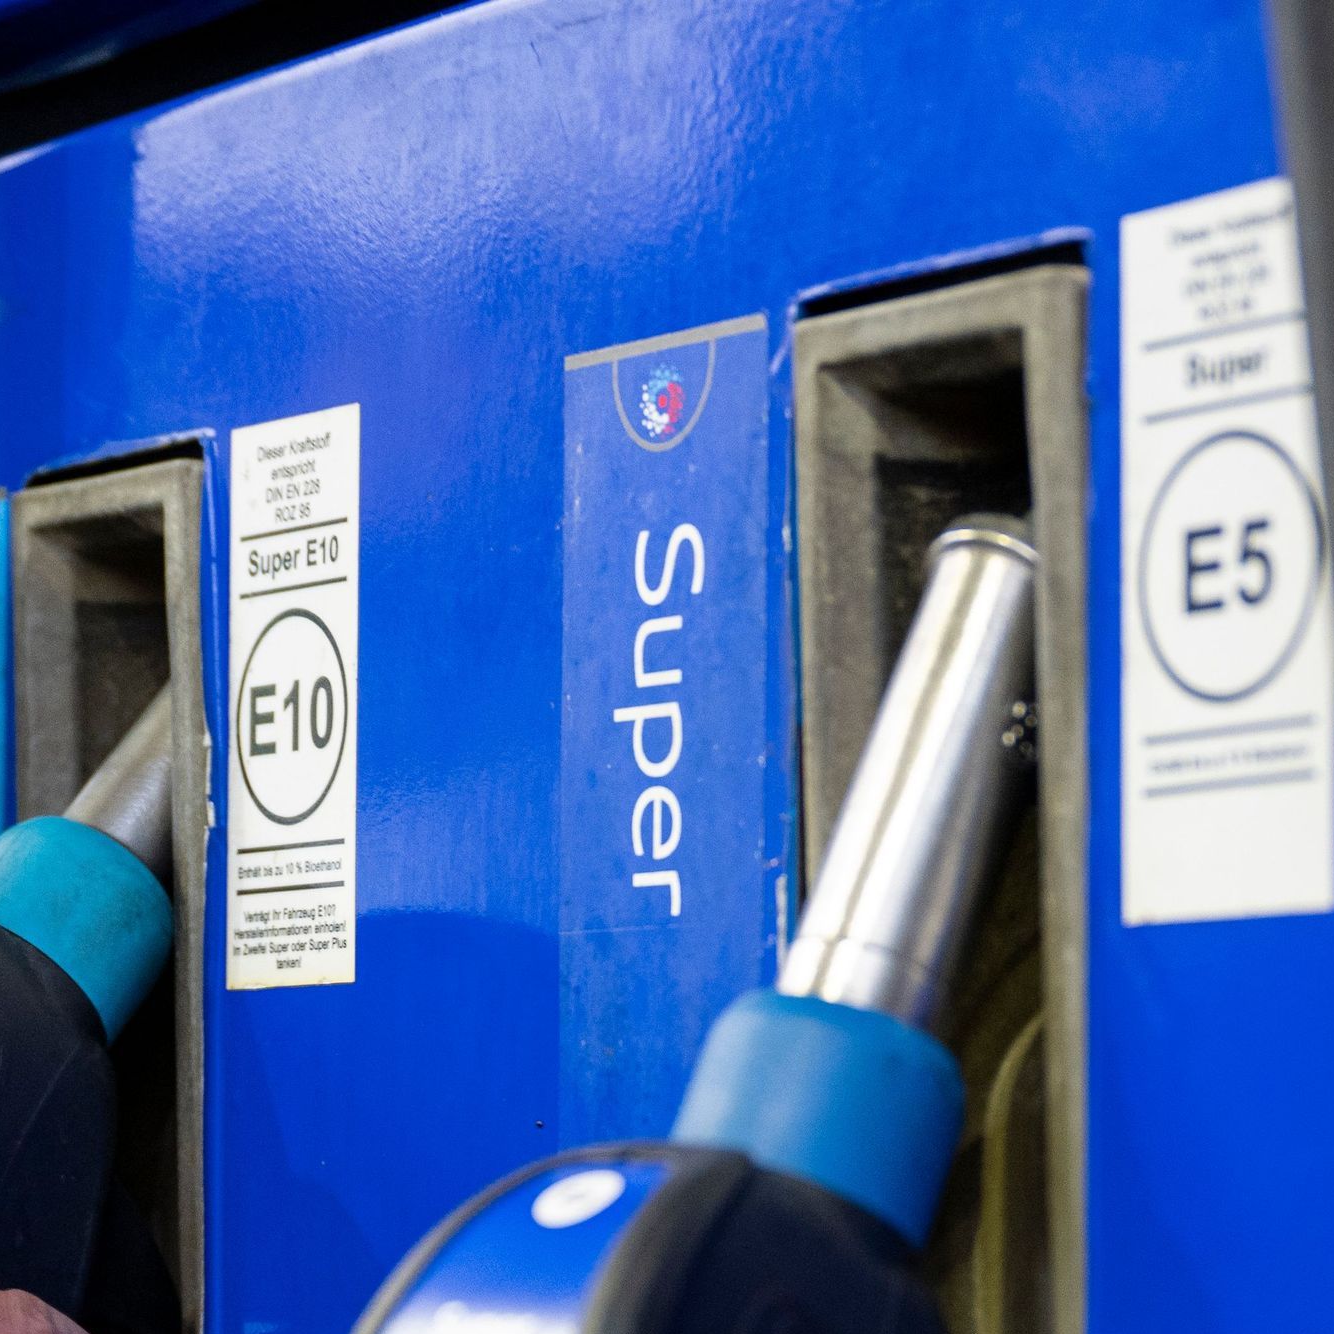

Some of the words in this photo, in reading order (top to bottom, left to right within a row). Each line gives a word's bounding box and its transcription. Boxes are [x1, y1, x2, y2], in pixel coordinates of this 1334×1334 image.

[271, 459, 315, 480] entspricht
[266, 487, 283, 503] DIN
[286, 483, 300, 499] EN
[275, 505, 296, 522] ROZ
[299, 502, 311, 519] 95
[248, 549, 300, 579] Super
[306, 535, 338, 567] E10
[1185, 519, 1272, 613] E5
[249, 675, 333, 757] E10
[614, 522, 706, 917] Super
[286, 861, 294, 874] 10
[296, 860, 303, 873] %
[305, 858, 342, 873] Bioethanol
[283, 906, 316, 920] Fahrzeug
[269, 941, 289, 956] Super
[291, 940, 308, 952] oder
[309, 938, 330, 953] Super
[332, 936, 348, 950] Plus
